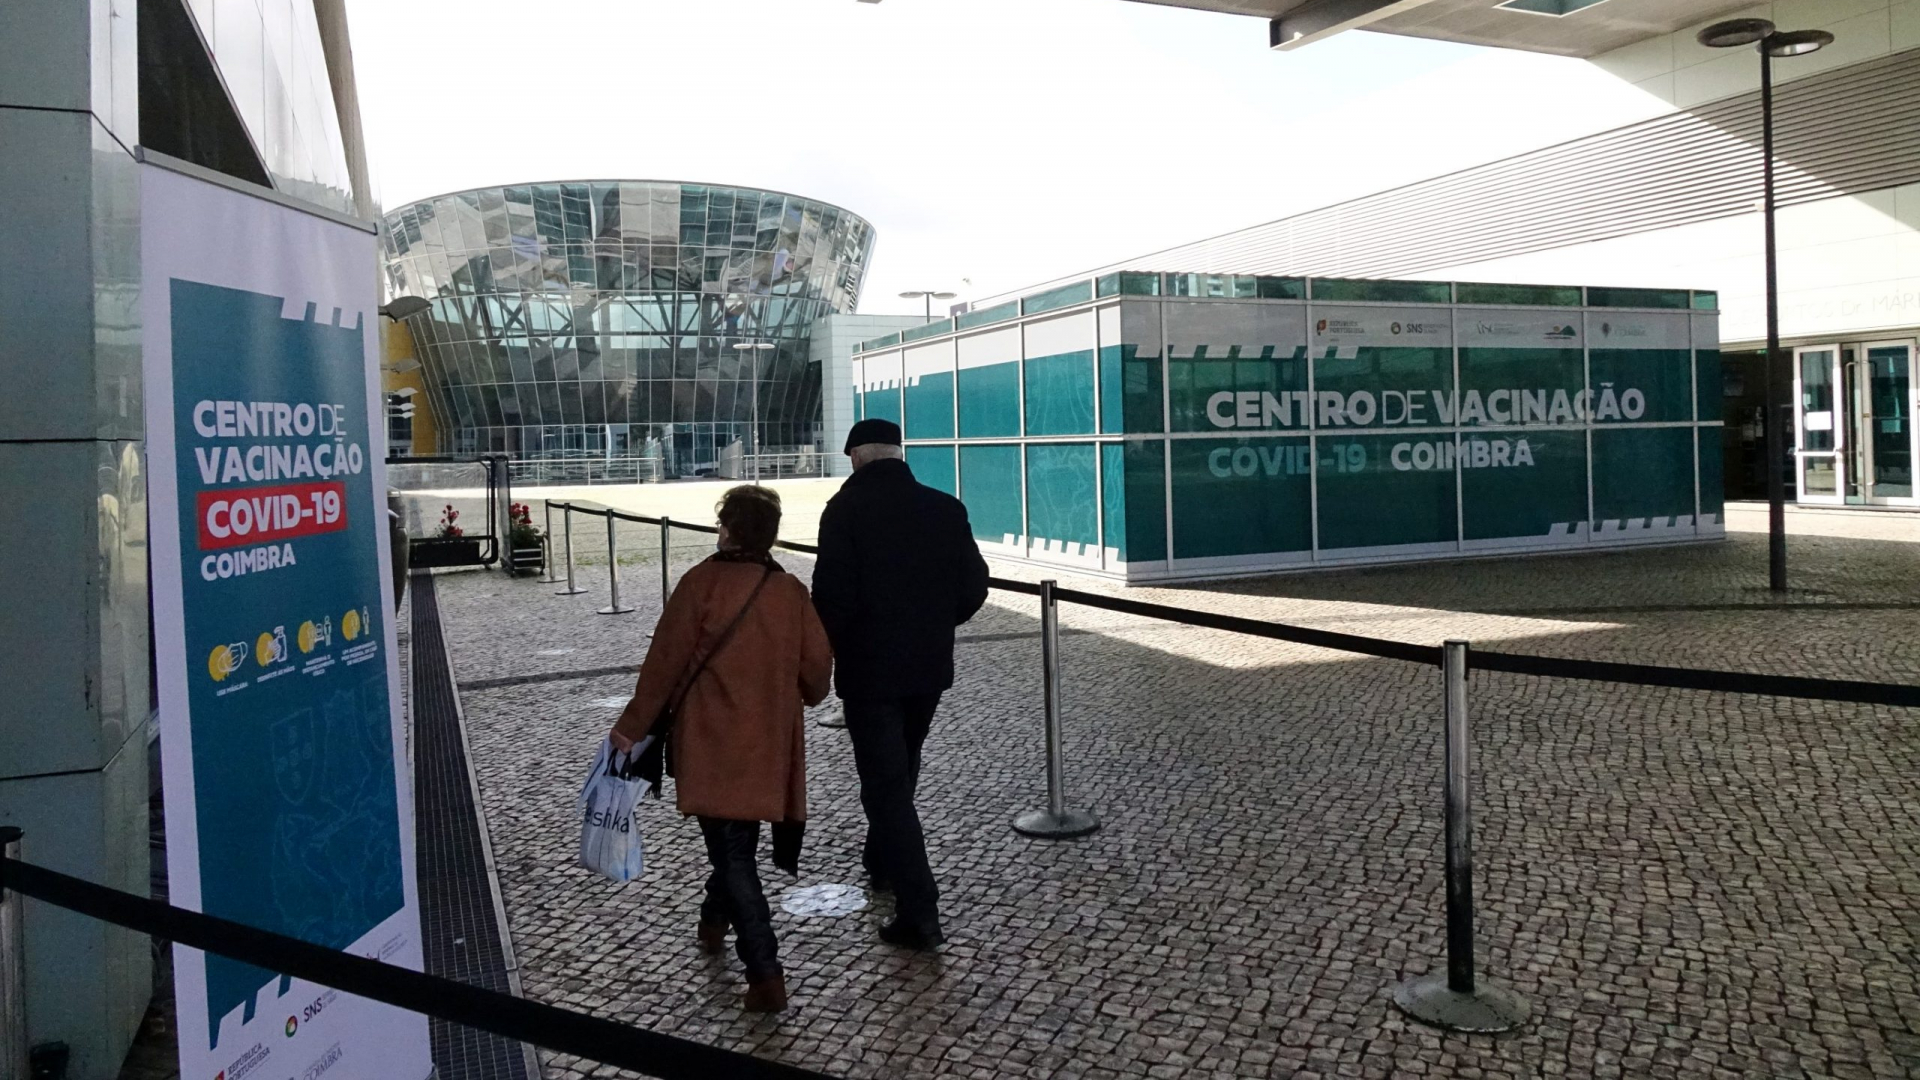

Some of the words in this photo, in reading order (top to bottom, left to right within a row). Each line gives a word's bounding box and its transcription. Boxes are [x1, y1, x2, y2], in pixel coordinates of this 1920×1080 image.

[1406, 323, 1423, 334] SNS
[193, 400, 315, 438] CENTRO
[318, 404, 346, 436] DE
[1206, 390, 1377, 428] CENTRO
[1382, 390, 1427, 424] DE
[1432, 382, 1645, 424] VACINAÇÃO
[195, 437, 363, 485] VACINAÇÃO
[1208, 443, 1367, 478] COVID-19
[1391, 439, 1535, 471] COIMBRA
[206, 490, 340, 539] COVID-19
[200, 542, 296, 582] COIMBRA
[303, 997, 323, 1023] SNS
[227, 1042, 262, 1075] REPÚBLICA
